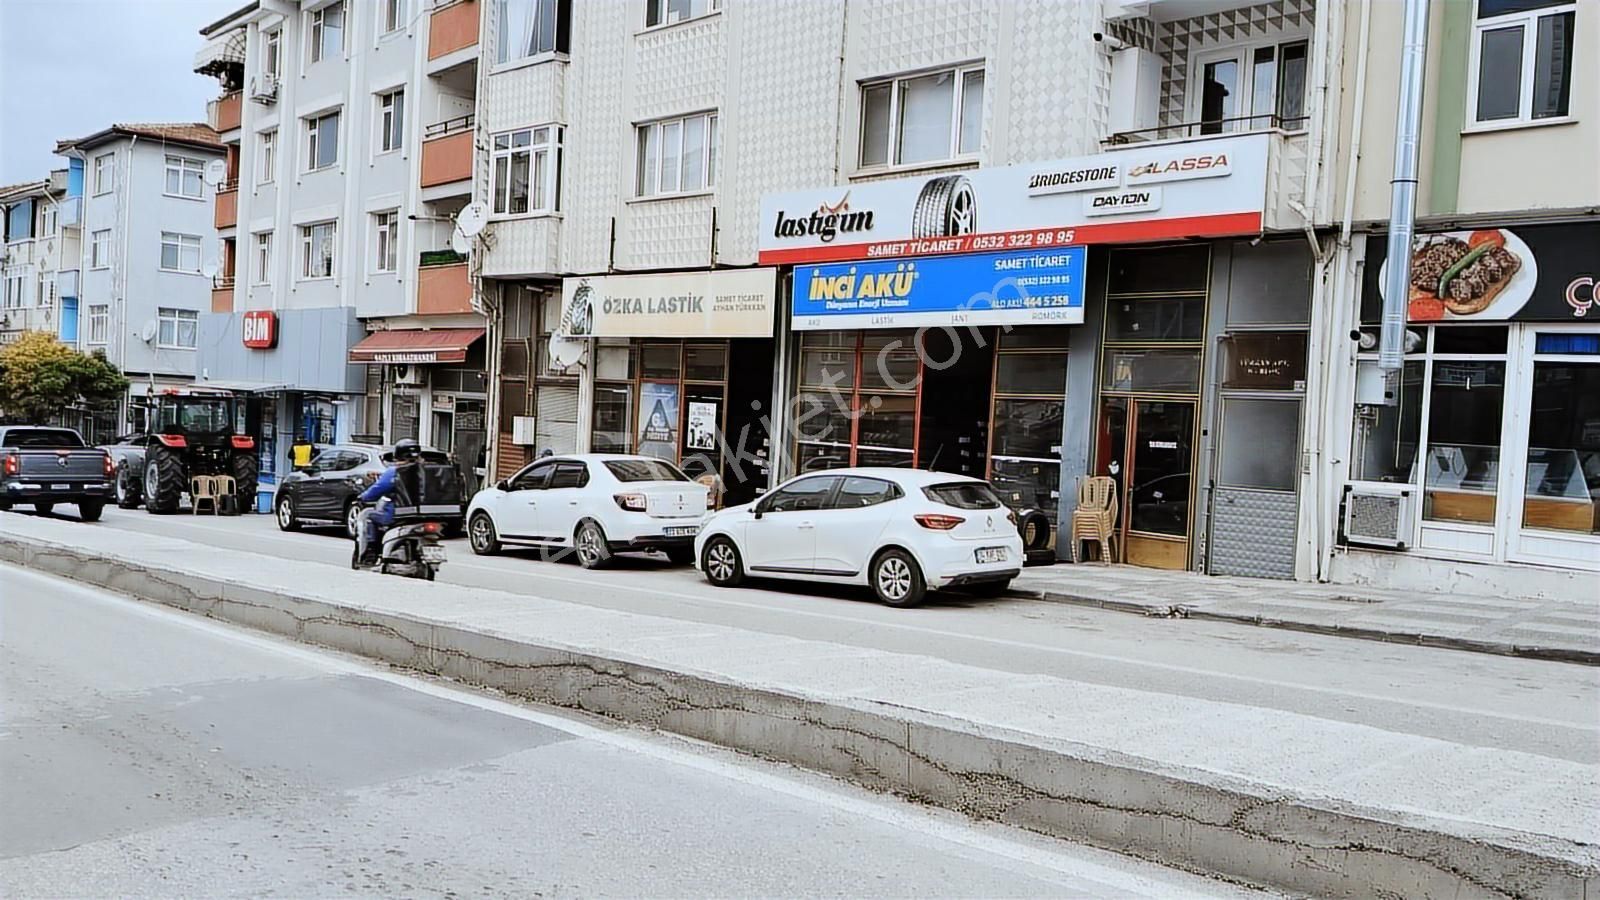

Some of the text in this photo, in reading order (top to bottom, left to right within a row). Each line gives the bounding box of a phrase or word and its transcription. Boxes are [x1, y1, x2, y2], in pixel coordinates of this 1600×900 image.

[1152, 154, 1228, 174] LASSA
[1028, 166, 1117, 188] BRIDGESTONE
[867, 242, 907, 257] SAMET
[910, 237, 963, 255] TİCARET
[972, 234, 1004, 249] 0532
[1008, 233, 1032, 247] 322
[1036, 231, 1053, 245] 98
[1056, 229, 1075, 243] 95
[994, 254, 1071, 271] SAMET TİCARET
[809, 262, 915, 300] İNCİ AKÜ
[602, 292, 704, 314] ÖZKA LASTİK
[1565, 276, 1600, 317] Ç
[244, 311, 269, 341] BİM
